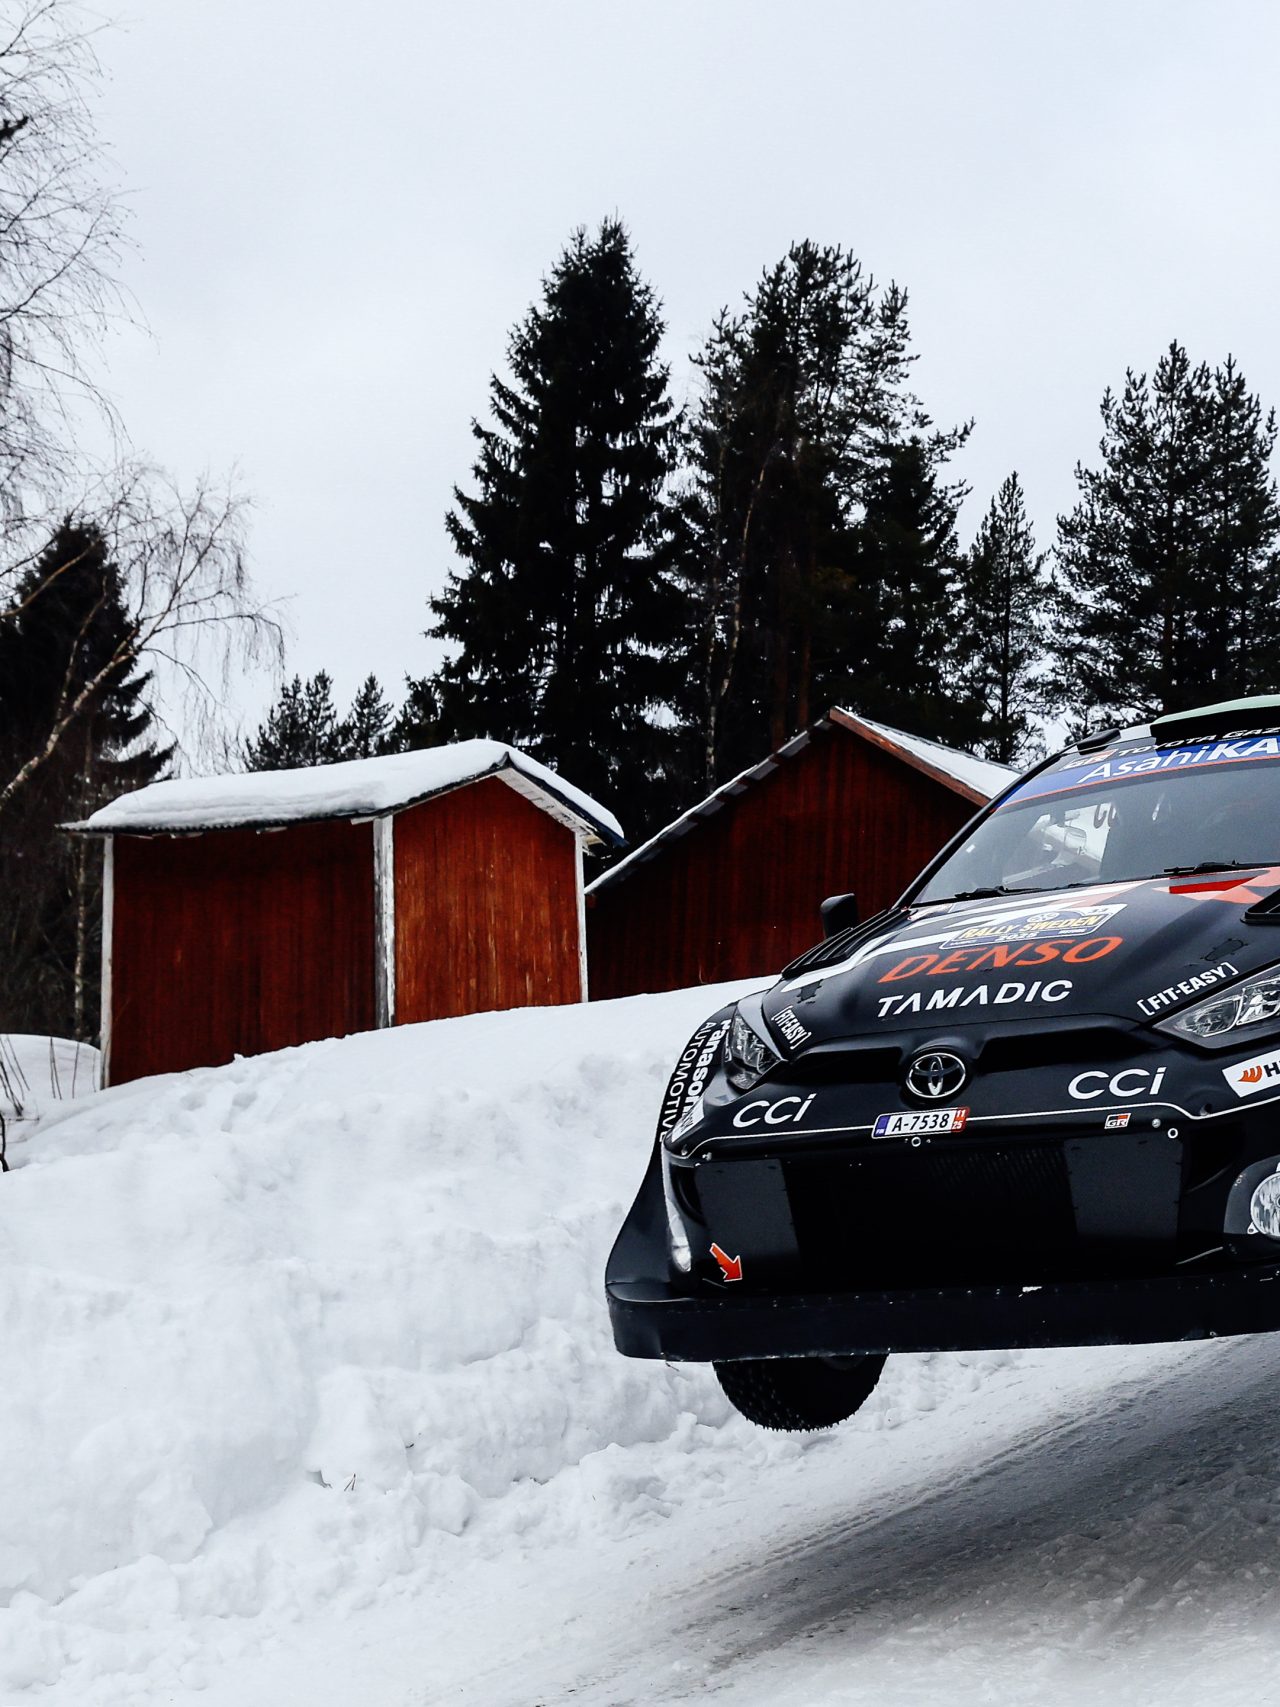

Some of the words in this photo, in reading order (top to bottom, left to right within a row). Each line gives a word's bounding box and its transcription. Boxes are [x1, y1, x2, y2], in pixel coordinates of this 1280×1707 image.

[1118, 734, 1217, 757] TOYOTA
[961, 925, 1019, 939] RALLY
[1019, 914, 1105, 932] SWEDEN
[877, 936, 1123, 984] DENSO
[877, 979, 1073, 1018] TAMADIC
[891, 1114, 950, 1132] A-7538
[952, 1121, 962, 1130] 25
